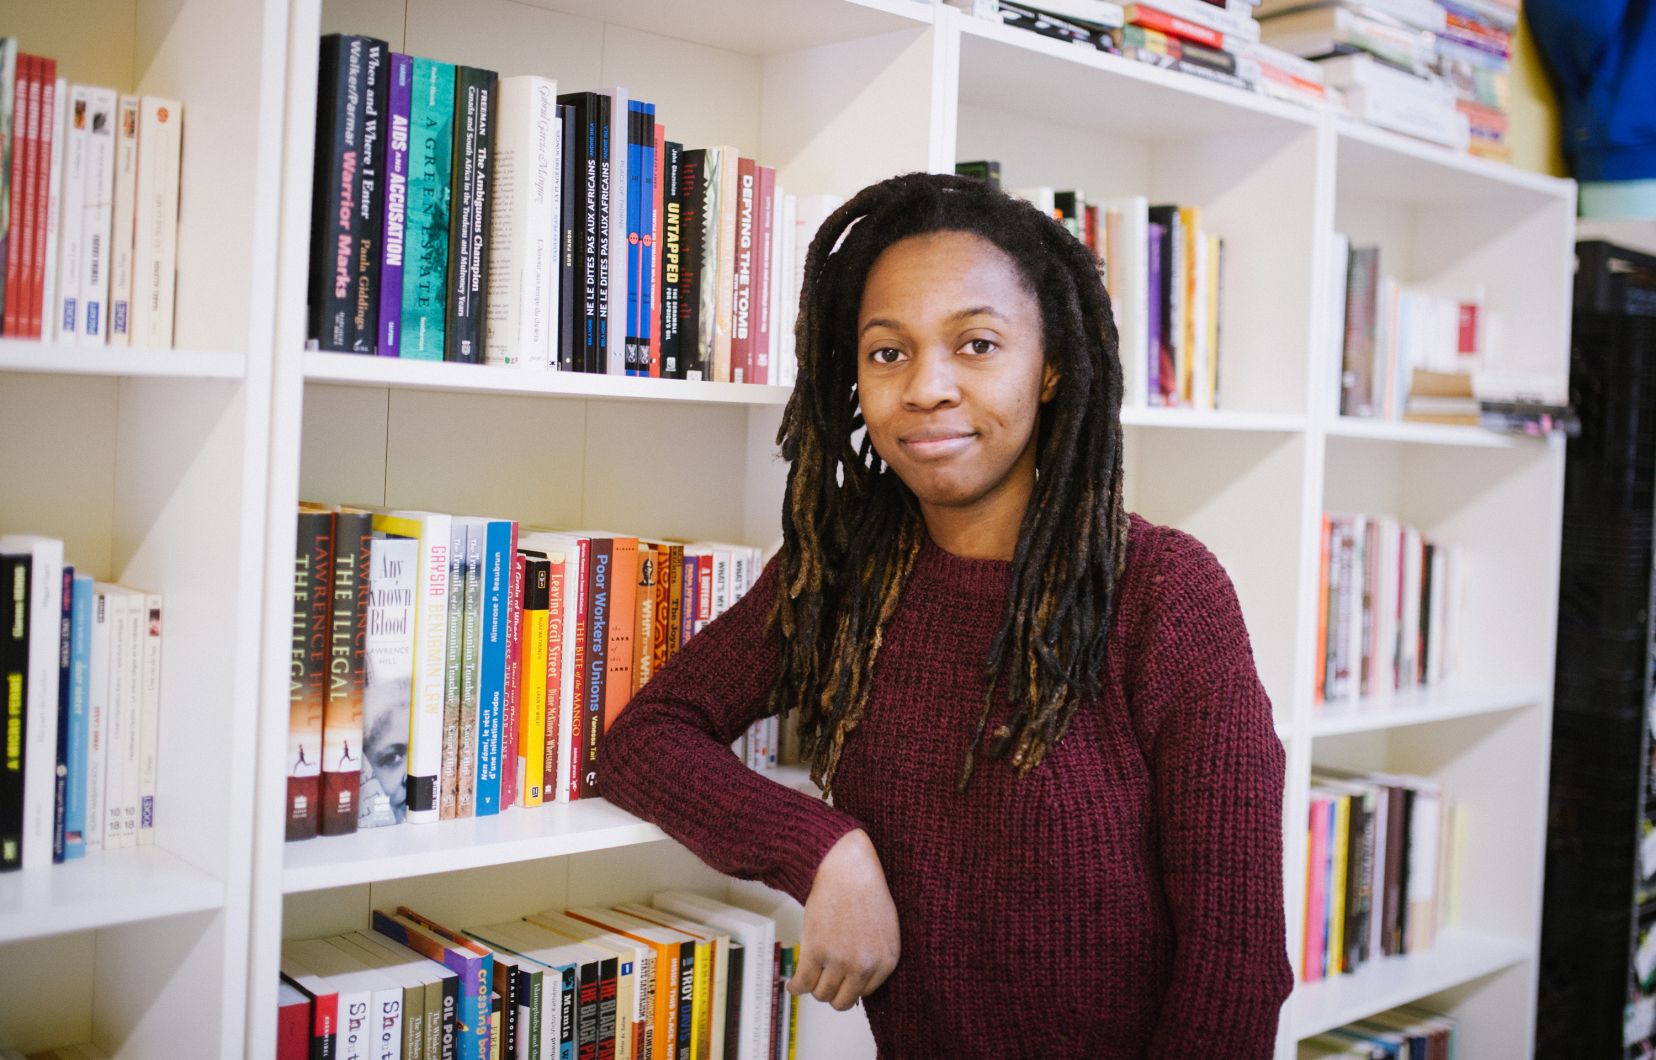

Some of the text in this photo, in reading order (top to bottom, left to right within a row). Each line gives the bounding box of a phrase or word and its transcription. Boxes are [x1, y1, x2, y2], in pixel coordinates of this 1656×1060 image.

[345, 40, 361, 147] Walker/Parmar
[391, 114, 408, 152] AIDS
[426, 117, 437, 128] A
[340, 151, 357, 230] Warrior
[355, 46, 380, 331] When and Where I Enter Paula Giddings
[423, 137, 437, 216] GREEN
[471, 89, 488, 292] FREEMAN The Ambiguous Champion
[587, 159, 596, 211] AFRICAINS
[601, 161, 609, 214] AFRICAINS
[387, 172, 406, 266] ACCUSATION
[458, 86, 476, 317] Canada and South Africa in the Trudeau and Mulroney Years
[587, 212, 595, 234] AUX
[601, 215, 609, 236] AUX
[666, 202, 680, 284] UNTAPPED
[587, 237, 595, 254] PAS
[600, 238, 608, 256] PAS
[738, 174, 754, 340] DEFYING THE TOMB
[335, 234, 351, 299] Marks
[418, 226, 433, 308] ESTATE
[587, 256, 595, 285] DITES
[600, 258, 608, 287] DITES
[587, 287, 594, 300] LE
[587, 302, 594, 316] NE
[600, 289, 608, 302] LE
[600, 303, 607, 318] NE
[294, 554, 310, 602] THE
[382, 552, 405, 584] Any
[452, 552, 464, 593] Travails
[467, 553, 480, 593] Travails
[354, 534, 371, 660] LAWRENCE
[490, 551, 502, 643] Mimerose P. Beaubrun
[546, 573, 563, 615] Leaving
[307, 534, 329, 728] LAWRENCE HILL
[329, 553, 355, 702] THE ILLEGAL
[370, 608, 408, 636] Blood
[424, 546, 447, 715] GAYSIA BENJAMIN LAW
[449, 611, 462, 661] Tanzanian
[465, 611, 478, 661] Tanzanian
[549, 618, 561, 642] Cecil
[575, 619, 585, 643] THE
[668, 598, 680, 647] The Joys
[547, 644, 561, 679] Street
[574, 671, 583, 680] of
[575, 645, 585, 669] BITE
[589, 554, 608, 761] Poor Workers' Unions Vanessa Tait
[447, 662, 460, 703] Teacher
[463, 662, 476, 703] Teacher
[547, 688, 558, 707] Diane
[574, 680, 582, 690] the
[482, 709, 491, 727] récit
[482, 729, 489, 737] le
[572, 692, 583, 737] MANGO
[488, 691, 500, 780] d'une initiation vodou
[481, 764, 489, 781] Nan
[110, 807, 121, 817] 10
[110, 820, 121, 831] 18
[125, 806, 136, 817] 10
[125, 819, 135, 830] 18
[443, 996, 454, 1021] OIL
[475, 969, 488, 1036] crossing
[532, 983, 541, 1031] Islamophobia
[562, 994, 572, 1039] Mumia
[579, 981, 599, 1045] THE BLACK
[599, 977, 618, 1041] THE BLACK
[639, 979, 648, 1019] CAPITALISM
[679, 968, 694, 1041] TROY DAVIS
[432, 1011, 441, 1053] The Whiskey
